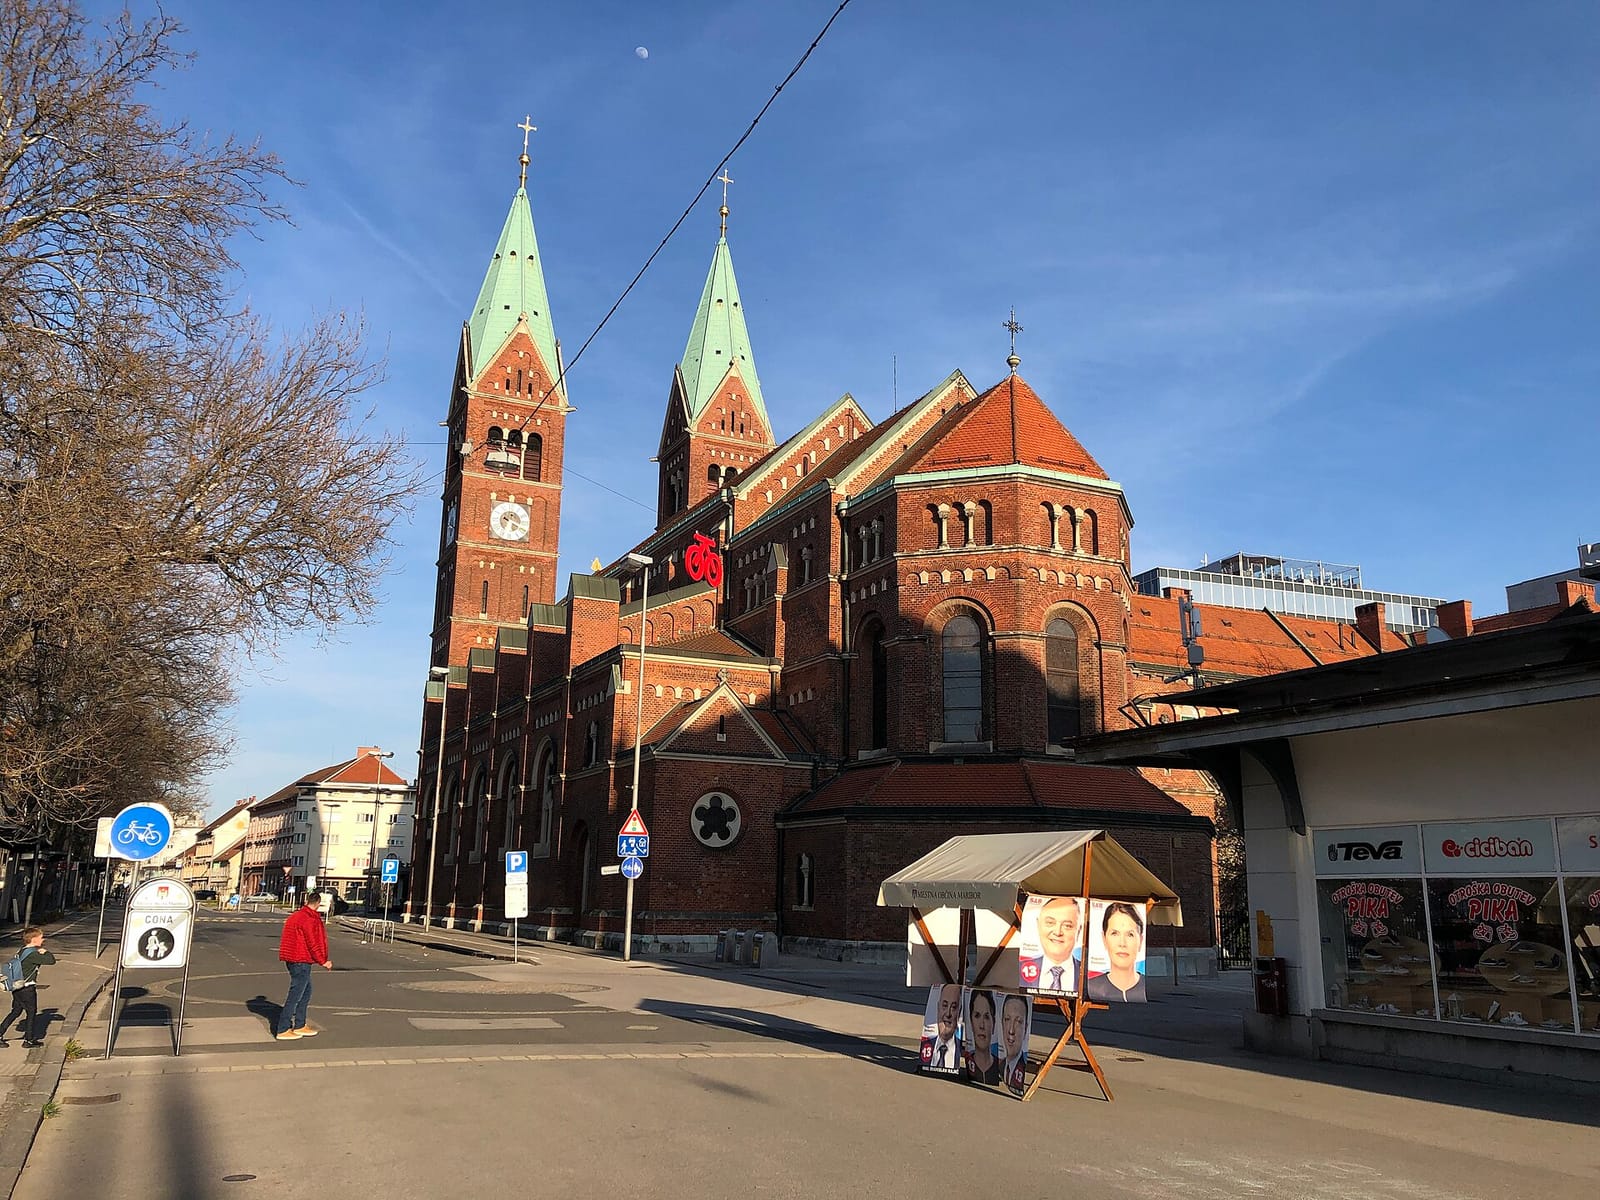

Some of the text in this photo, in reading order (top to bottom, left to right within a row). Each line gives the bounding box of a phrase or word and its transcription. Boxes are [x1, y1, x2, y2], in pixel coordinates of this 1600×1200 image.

[1464, 837, 1534, 858] ciciban
[385, 861, 395, 873] P
[510, 854, 523, 871] P
[1332, 881, 1404, 904] OTROŠKA OBUTEV
[1448, 881, 1537, 906] OTROŠKA OBUTEV
[1347, 896, 1389, 919] PIKA
[1467, 898, 1519, 922] PIKA
[145, 915, 173, 924] CONA
[1022, 965, 1037, 978] 13
[922, 1046, 932, 1061] 13
[1015, 1069, 1023, 1082] 13
